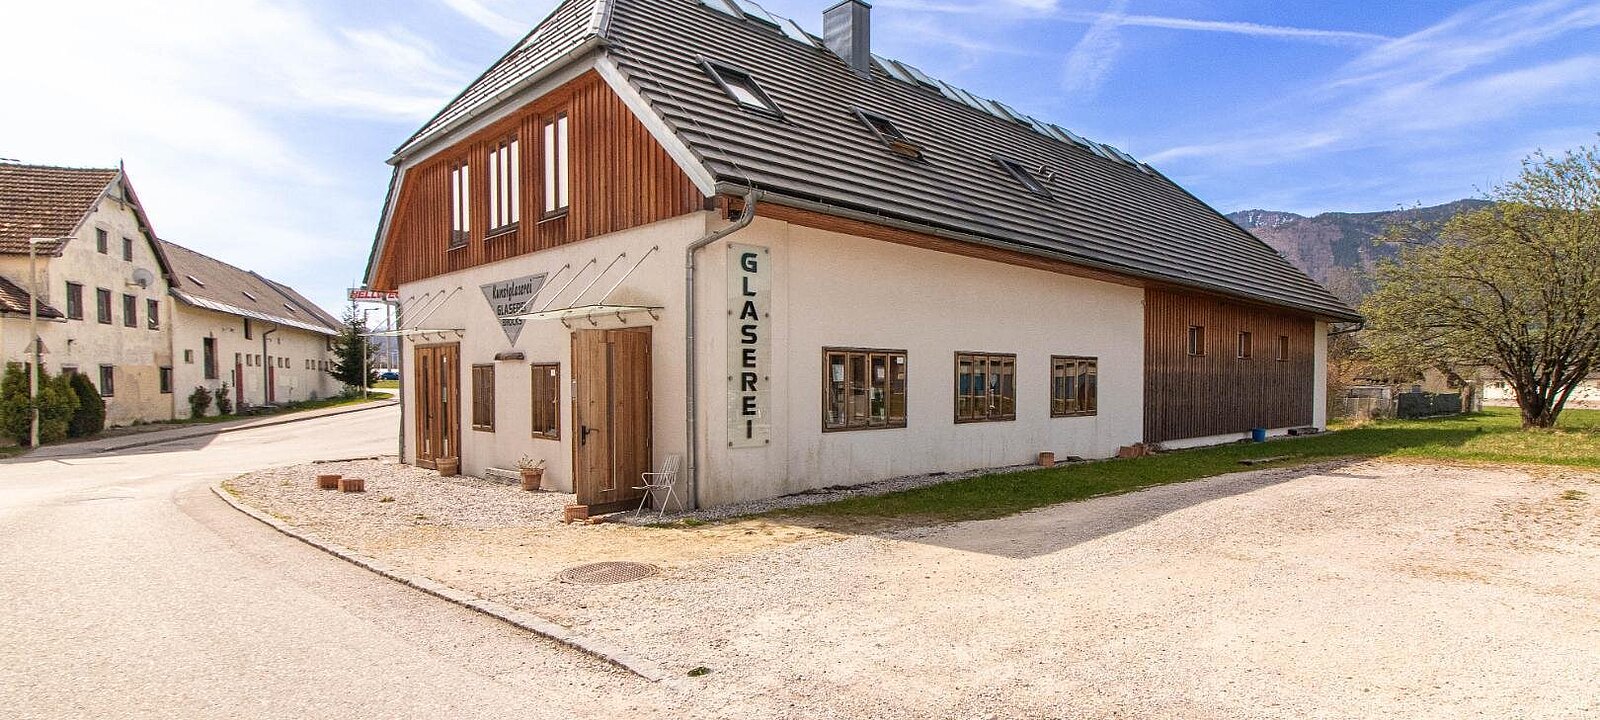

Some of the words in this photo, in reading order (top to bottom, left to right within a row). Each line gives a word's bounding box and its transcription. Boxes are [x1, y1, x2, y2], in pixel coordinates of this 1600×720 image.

[350, 290, 399, 299] HELLE
[492, 278, 532, 301] Kunstglaserei
[740, 252, 759, 440] GLASEREI
